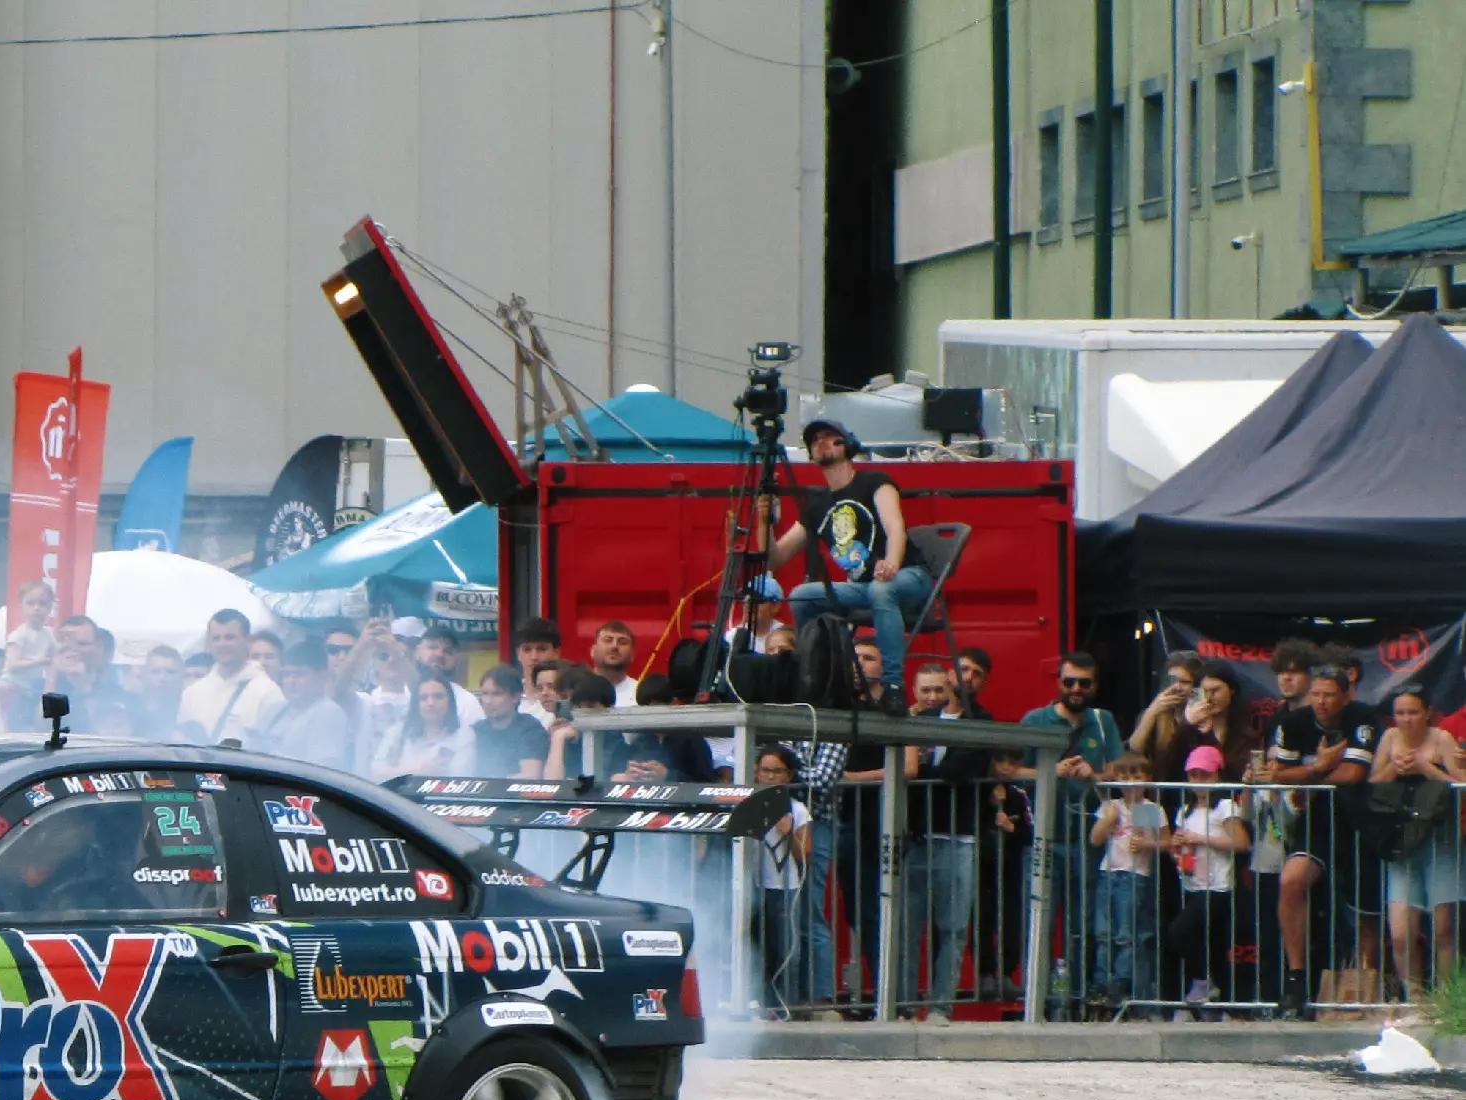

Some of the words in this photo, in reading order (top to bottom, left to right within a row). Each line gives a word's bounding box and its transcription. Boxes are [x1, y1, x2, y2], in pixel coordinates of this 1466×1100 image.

[62, 773, 116, 793] Mobil
[416, 780, 469, 794] Mobil
[605, 784, 657, 799] Mobil
[153, 806, 202, 836] 24
[263, 796, 324, 827] ProX
[423, 804, 498, 818] COVINA
[616, 811, 714, 829] Mobil
[278, 838, 374, 874] Mobil
[292, 882, 417, 906] lubexpert.ro
[409, 919, 552, 972] Mobil
